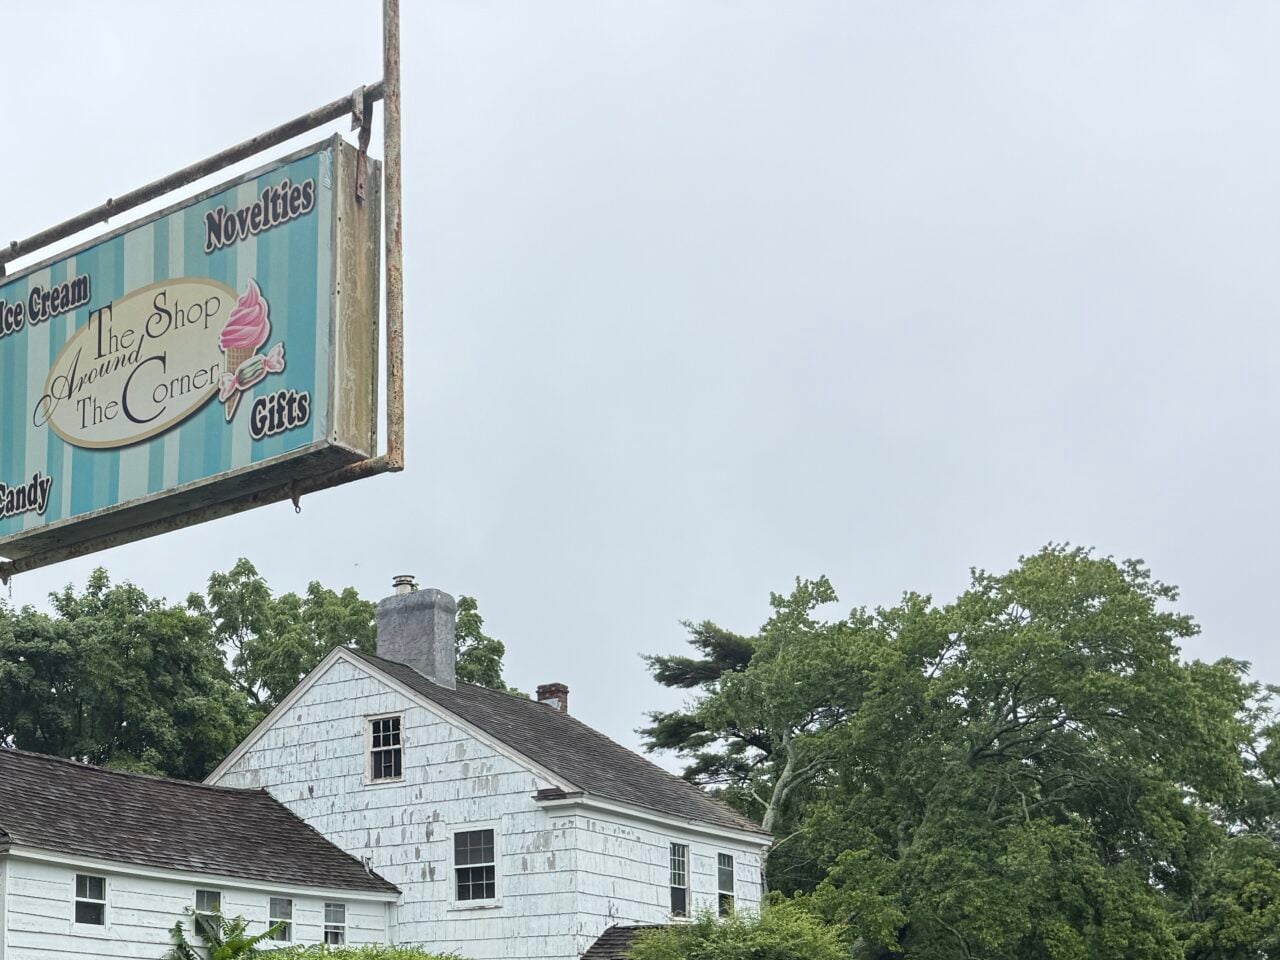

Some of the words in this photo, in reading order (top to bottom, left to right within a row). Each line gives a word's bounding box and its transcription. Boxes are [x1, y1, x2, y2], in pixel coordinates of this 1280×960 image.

[205, 180, 313, 250] Novelties
[28, 275, 89, 322] Cream
[89, 301, 135, 360] The
[145, 289, 221, 339] Shop
[33, 334, 145, 428] Around
[76, 396, 120, 430] The
[122, 350, 220, 424] Corner
[250, 390, 309, 437] Gifts
